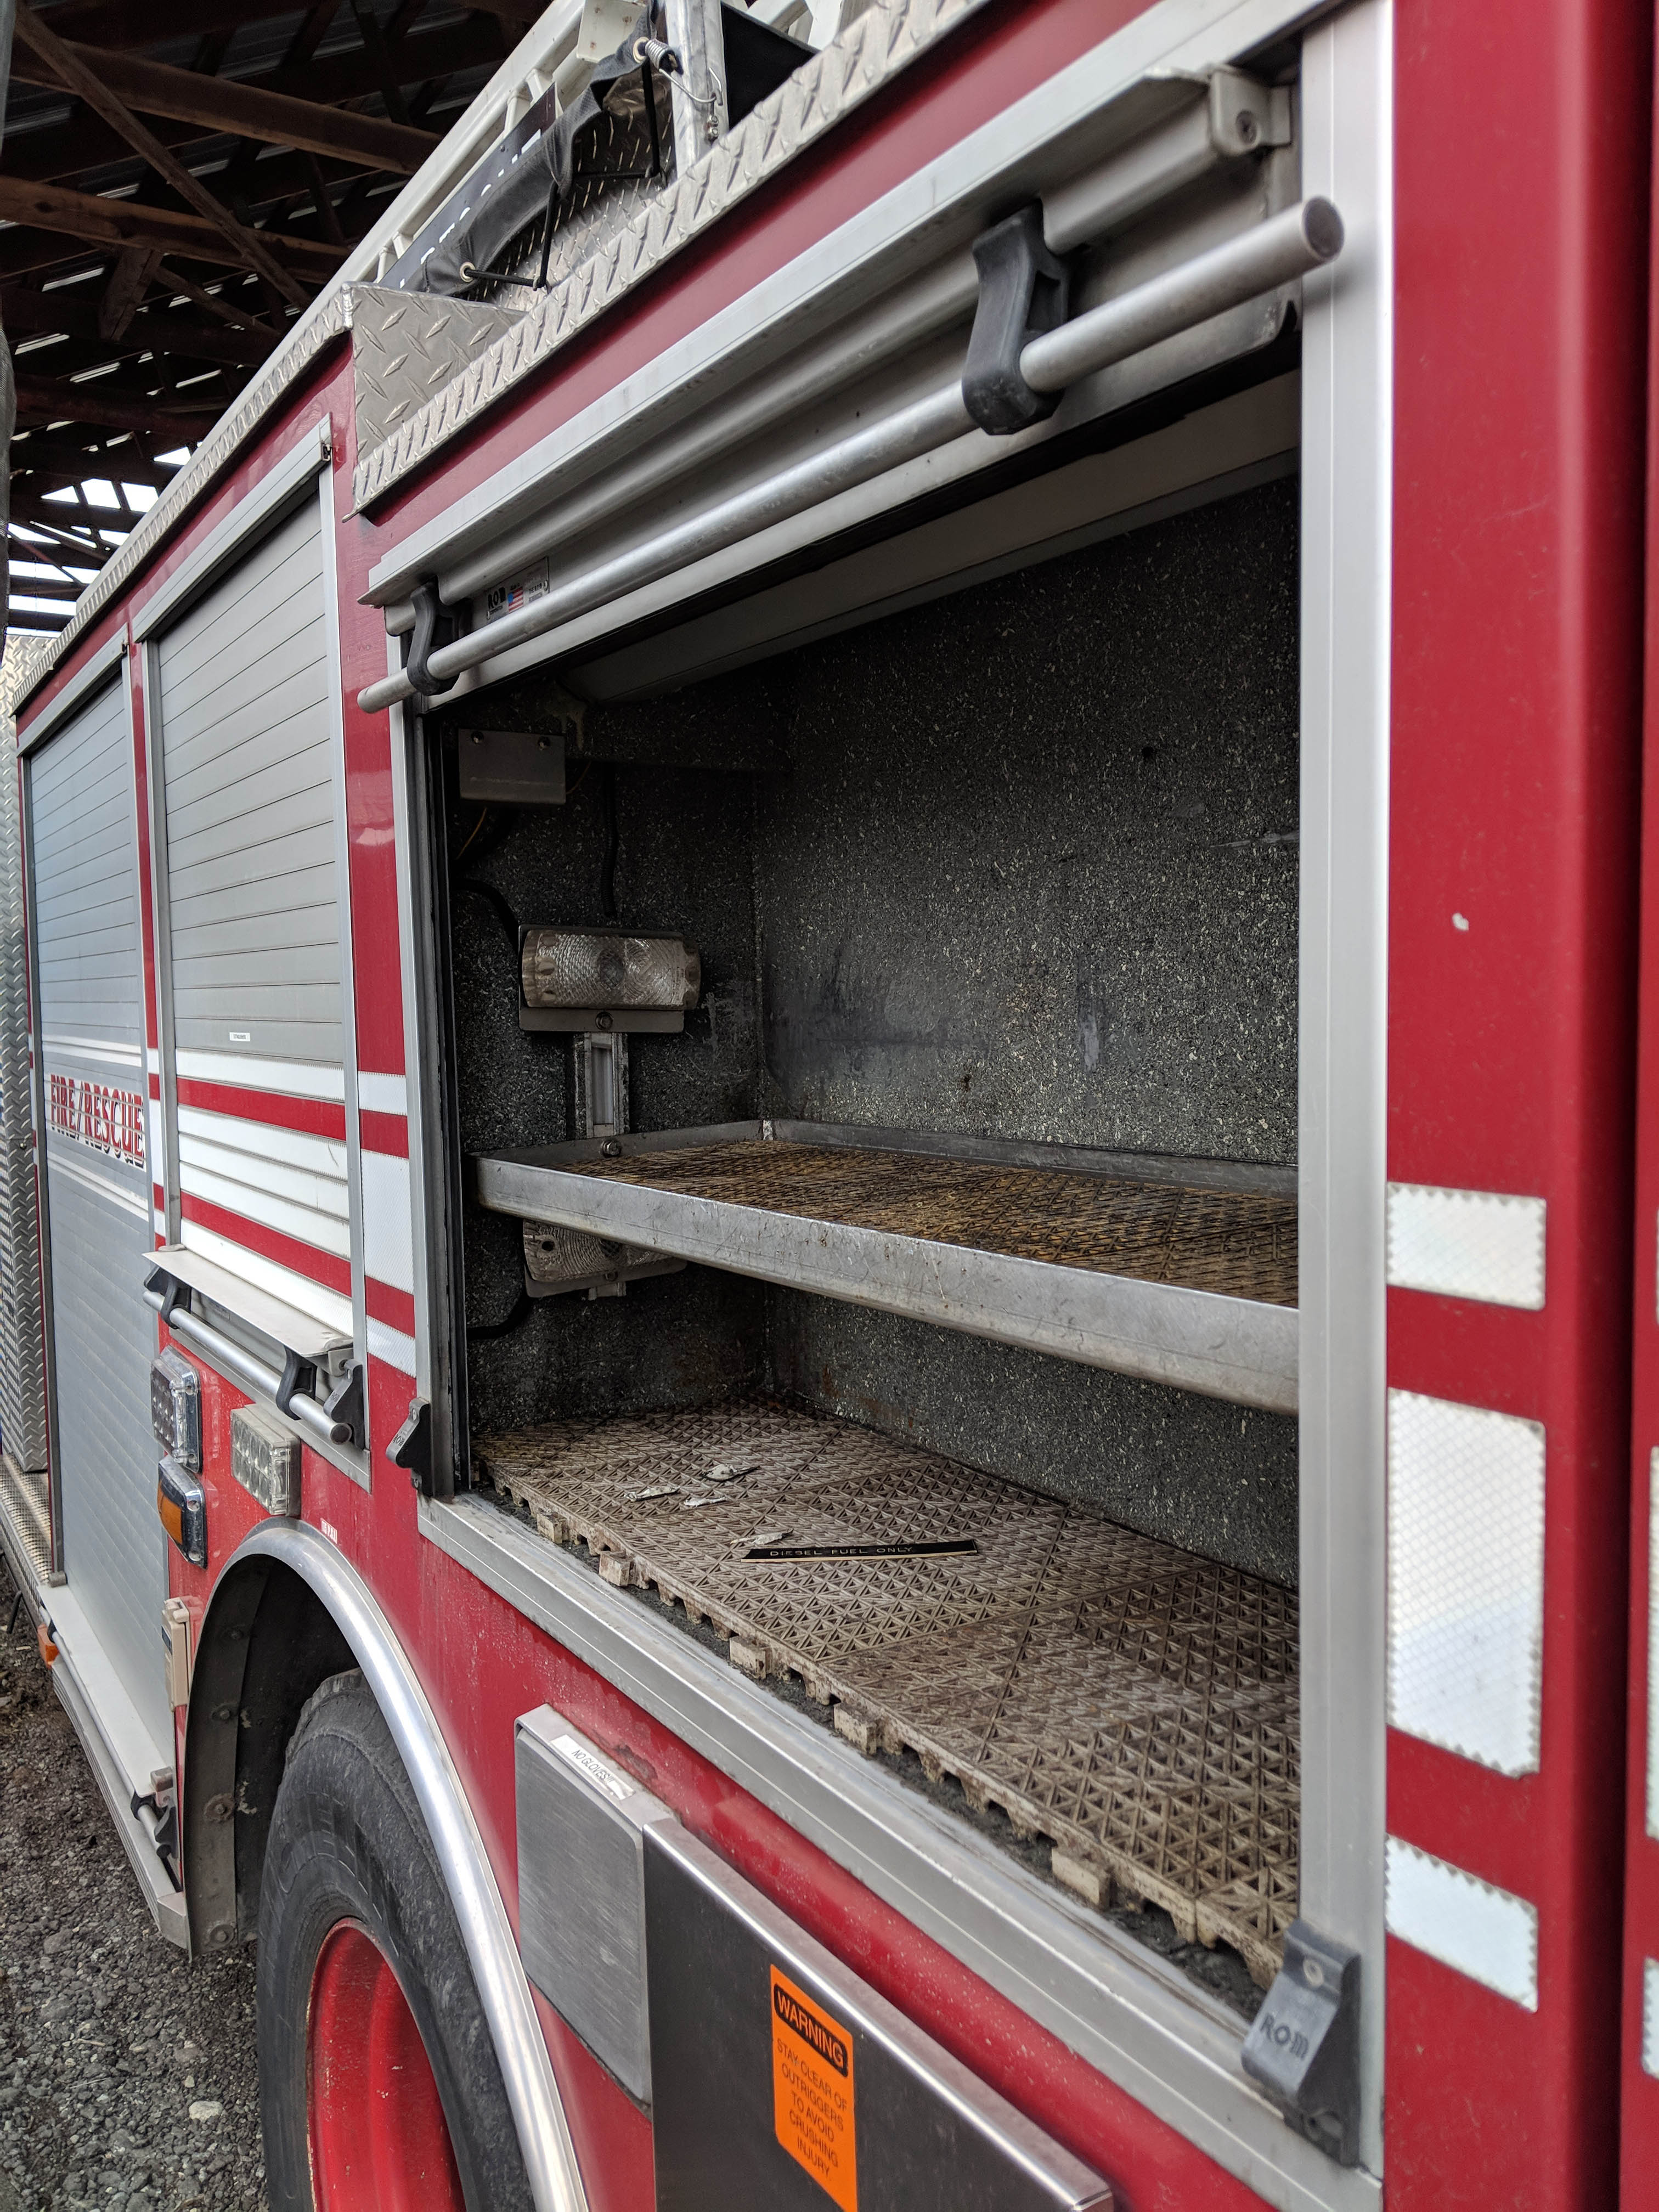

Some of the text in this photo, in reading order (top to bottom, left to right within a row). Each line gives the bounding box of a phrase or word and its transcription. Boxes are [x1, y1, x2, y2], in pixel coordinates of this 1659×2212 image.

[571, 1750, 586, 1760] NO
[777, 1990, 844, 2069] WARNING
[777, 2038, 847, 2112] STAY CLEAR OF
[781, 2062, 843, 2132] OUTRIGGERS
[789, 2109, 838, 2168] CRUSHING
[791, 2090, 834, 2142] TO AVOID
